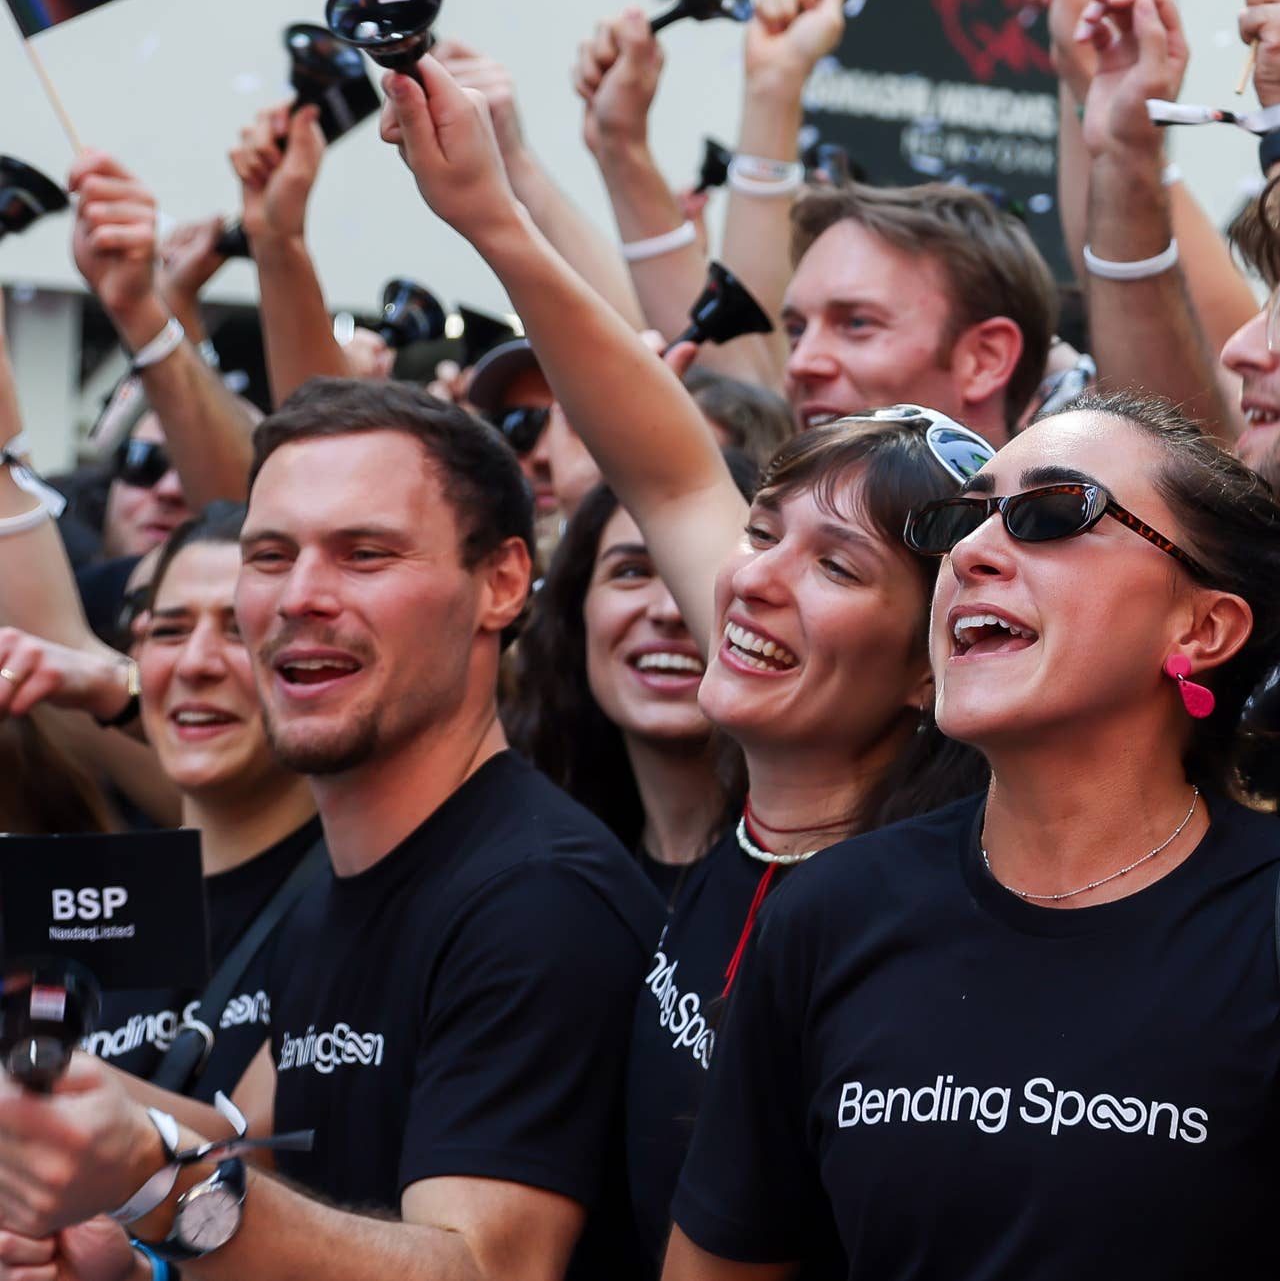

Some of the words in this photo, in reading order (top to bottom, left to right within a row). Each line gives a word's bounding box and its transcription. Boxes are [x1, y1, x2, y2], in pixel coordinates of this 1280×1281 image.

[52, 886, 128, 921] BSP
[82, 1010, 178, 1058] nding
[838, 1075, 1011, 1134] Bending
[1019, 1077, 1209, 1144] Spoons
